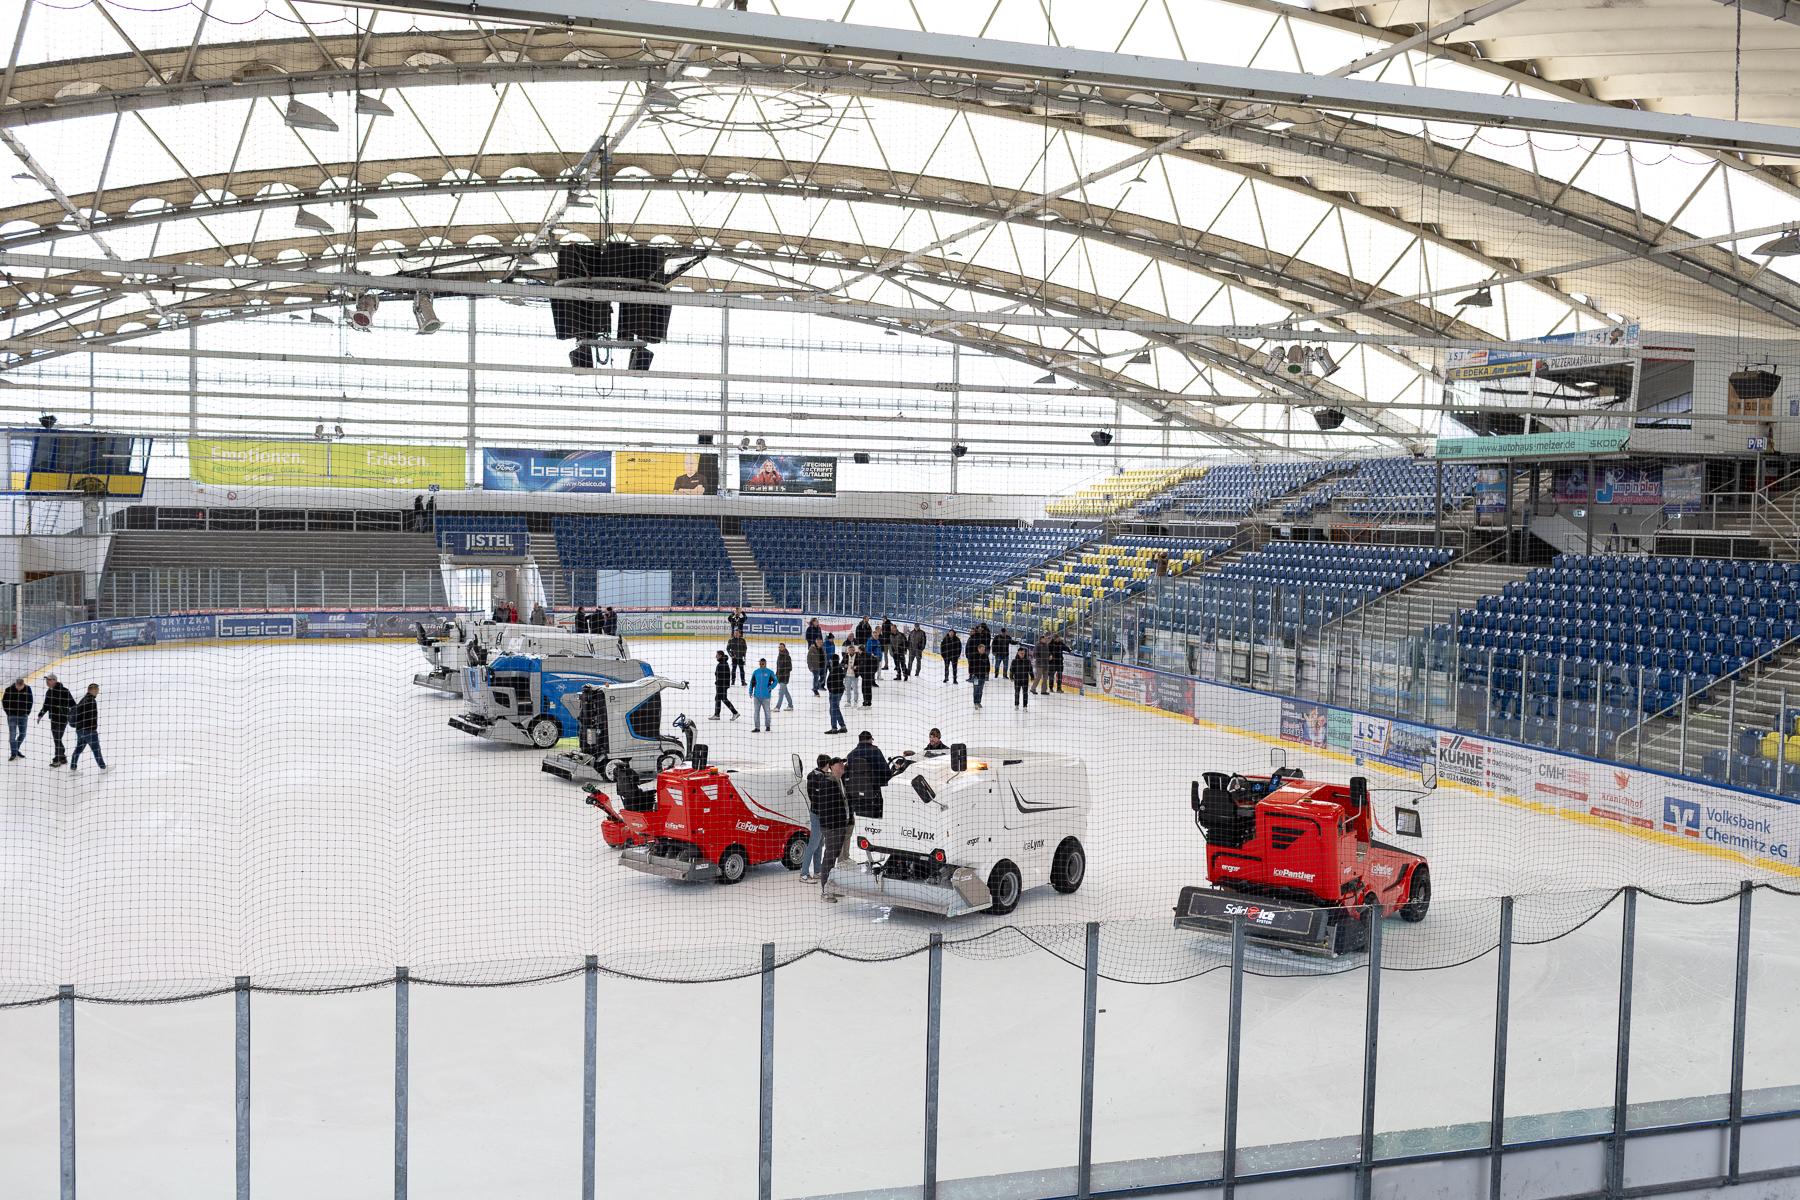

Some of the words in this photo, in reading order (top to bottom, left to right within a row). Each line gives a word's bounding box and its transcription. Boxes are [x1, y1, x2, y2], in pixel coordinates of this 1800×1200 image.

[1464, 368, 1489, 377] EDEKA
[495, 463, 516, 472] Ford
[530, 457, 607, 478] besico
[465, 534, 514, 550] JISTEL
[220, 620, 292, 636] besico
[664, 620, 685, 630] ctb
[1358, 721, 1386, 742] LST
[1538, 763, 1566, 780] CMH
[1706, 806, 1771, 834] Volksbank
[900, 826, 935, 841] IceLynx
[1705, 826, 1766, 853] Chemnitz
[1769, 844, 1788, 858] eG
[1223, 903, 1249, 915] Solid
